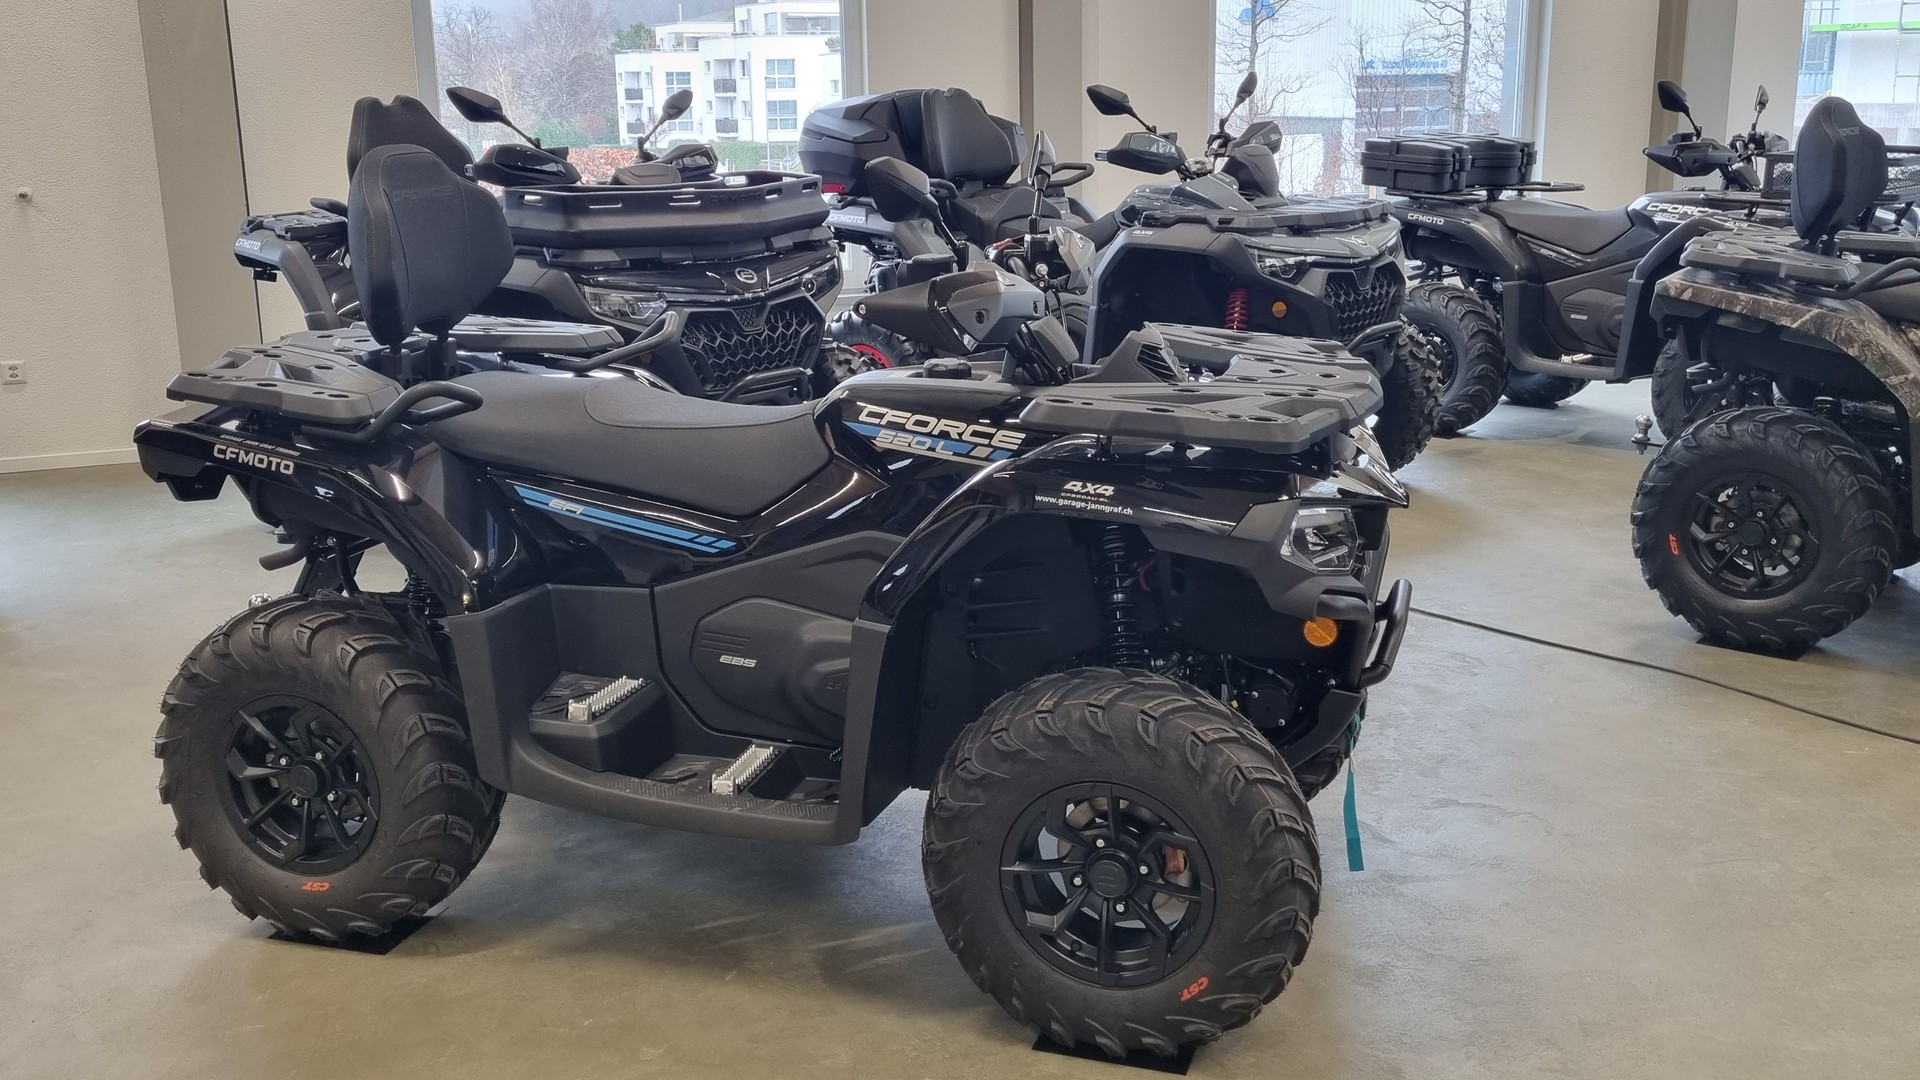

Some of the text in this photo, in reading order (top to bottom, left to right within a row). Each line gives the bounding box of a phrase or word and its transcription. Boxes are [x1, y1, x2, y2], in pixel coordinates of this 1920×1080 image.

[828, 213, 866, 224] CFMOTO
[1407, 212, 1445, 225] CFMOTO
[235, 238, 261, 251] CFMOTO
[858, 406, 1026, 450] CFORCE
[876, 429, 953, 455] 520 L
[213, 444, 294, 475] CFMOTO
[1064, 481, 1115, 496] 4X4
[1034, 494, 1133, 516] www.garage-janngraf.ch
[1669, 533, 1679, 555] CST
[719, 655, 757, 668] EBS
[302, 881, 330, 891] CST
[1180, 976, 1209, 1001] CST
